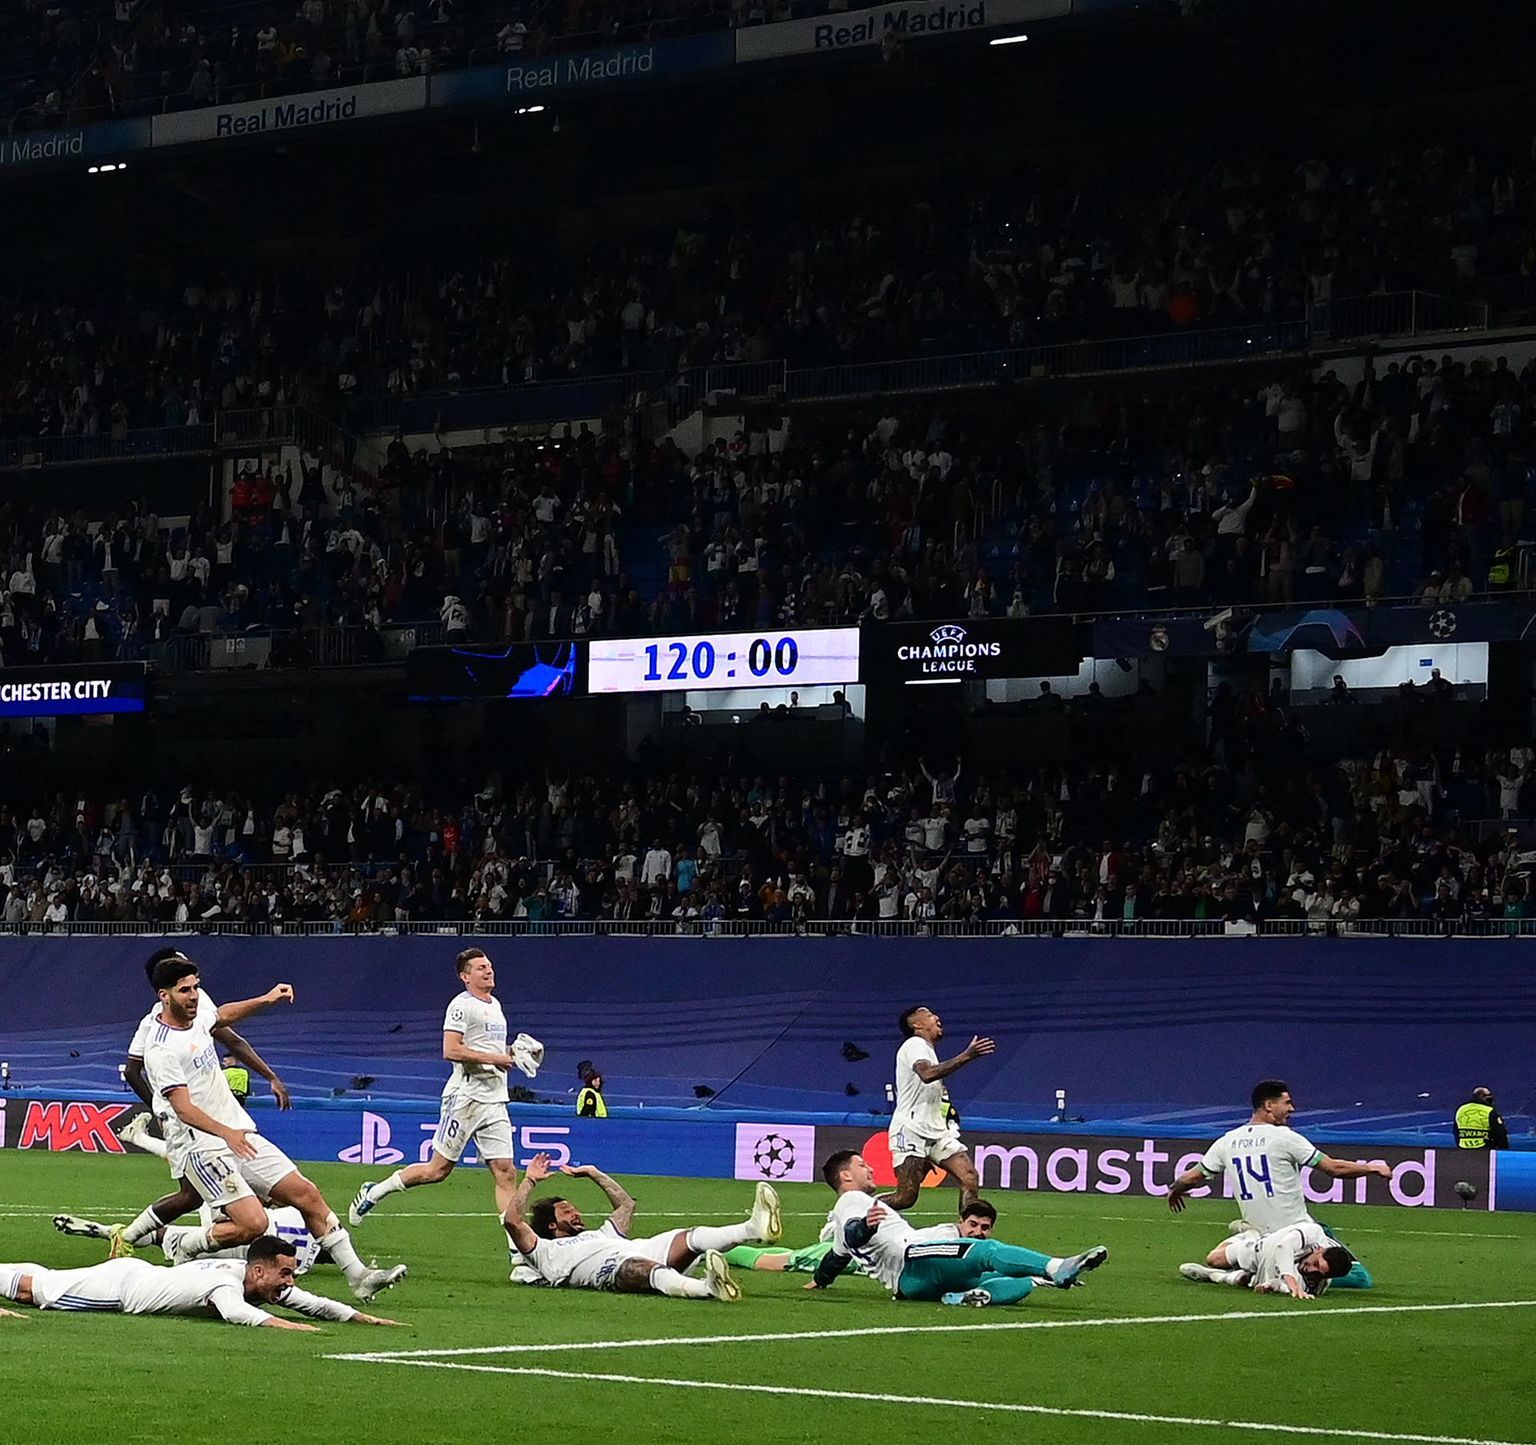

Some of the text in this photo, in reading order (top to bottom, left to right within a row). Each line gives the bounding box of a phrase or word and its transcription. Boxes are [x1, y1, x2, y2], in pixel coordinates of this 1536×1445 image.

[814, 3, 985, 48] Real Madrid
[506, 48, 654, 92] Real Madrid
[216, 97, 356, 137] Real Madrid
[12, 131, 83, 164] Madrid
[931, 628, 964, 642] UEFA
[897, 642, 1001, 660] CHAMPIONS
[922, 659, 975, 673] LEAGUE
[73, 679, 112, 700] CITY
[17, 1100, 133, 1155] MAX
[447, 1118, 460, 1139] 8
[203, 1156, 234, 1181] 11
[1231, 1153, 1275, 1200] 14
